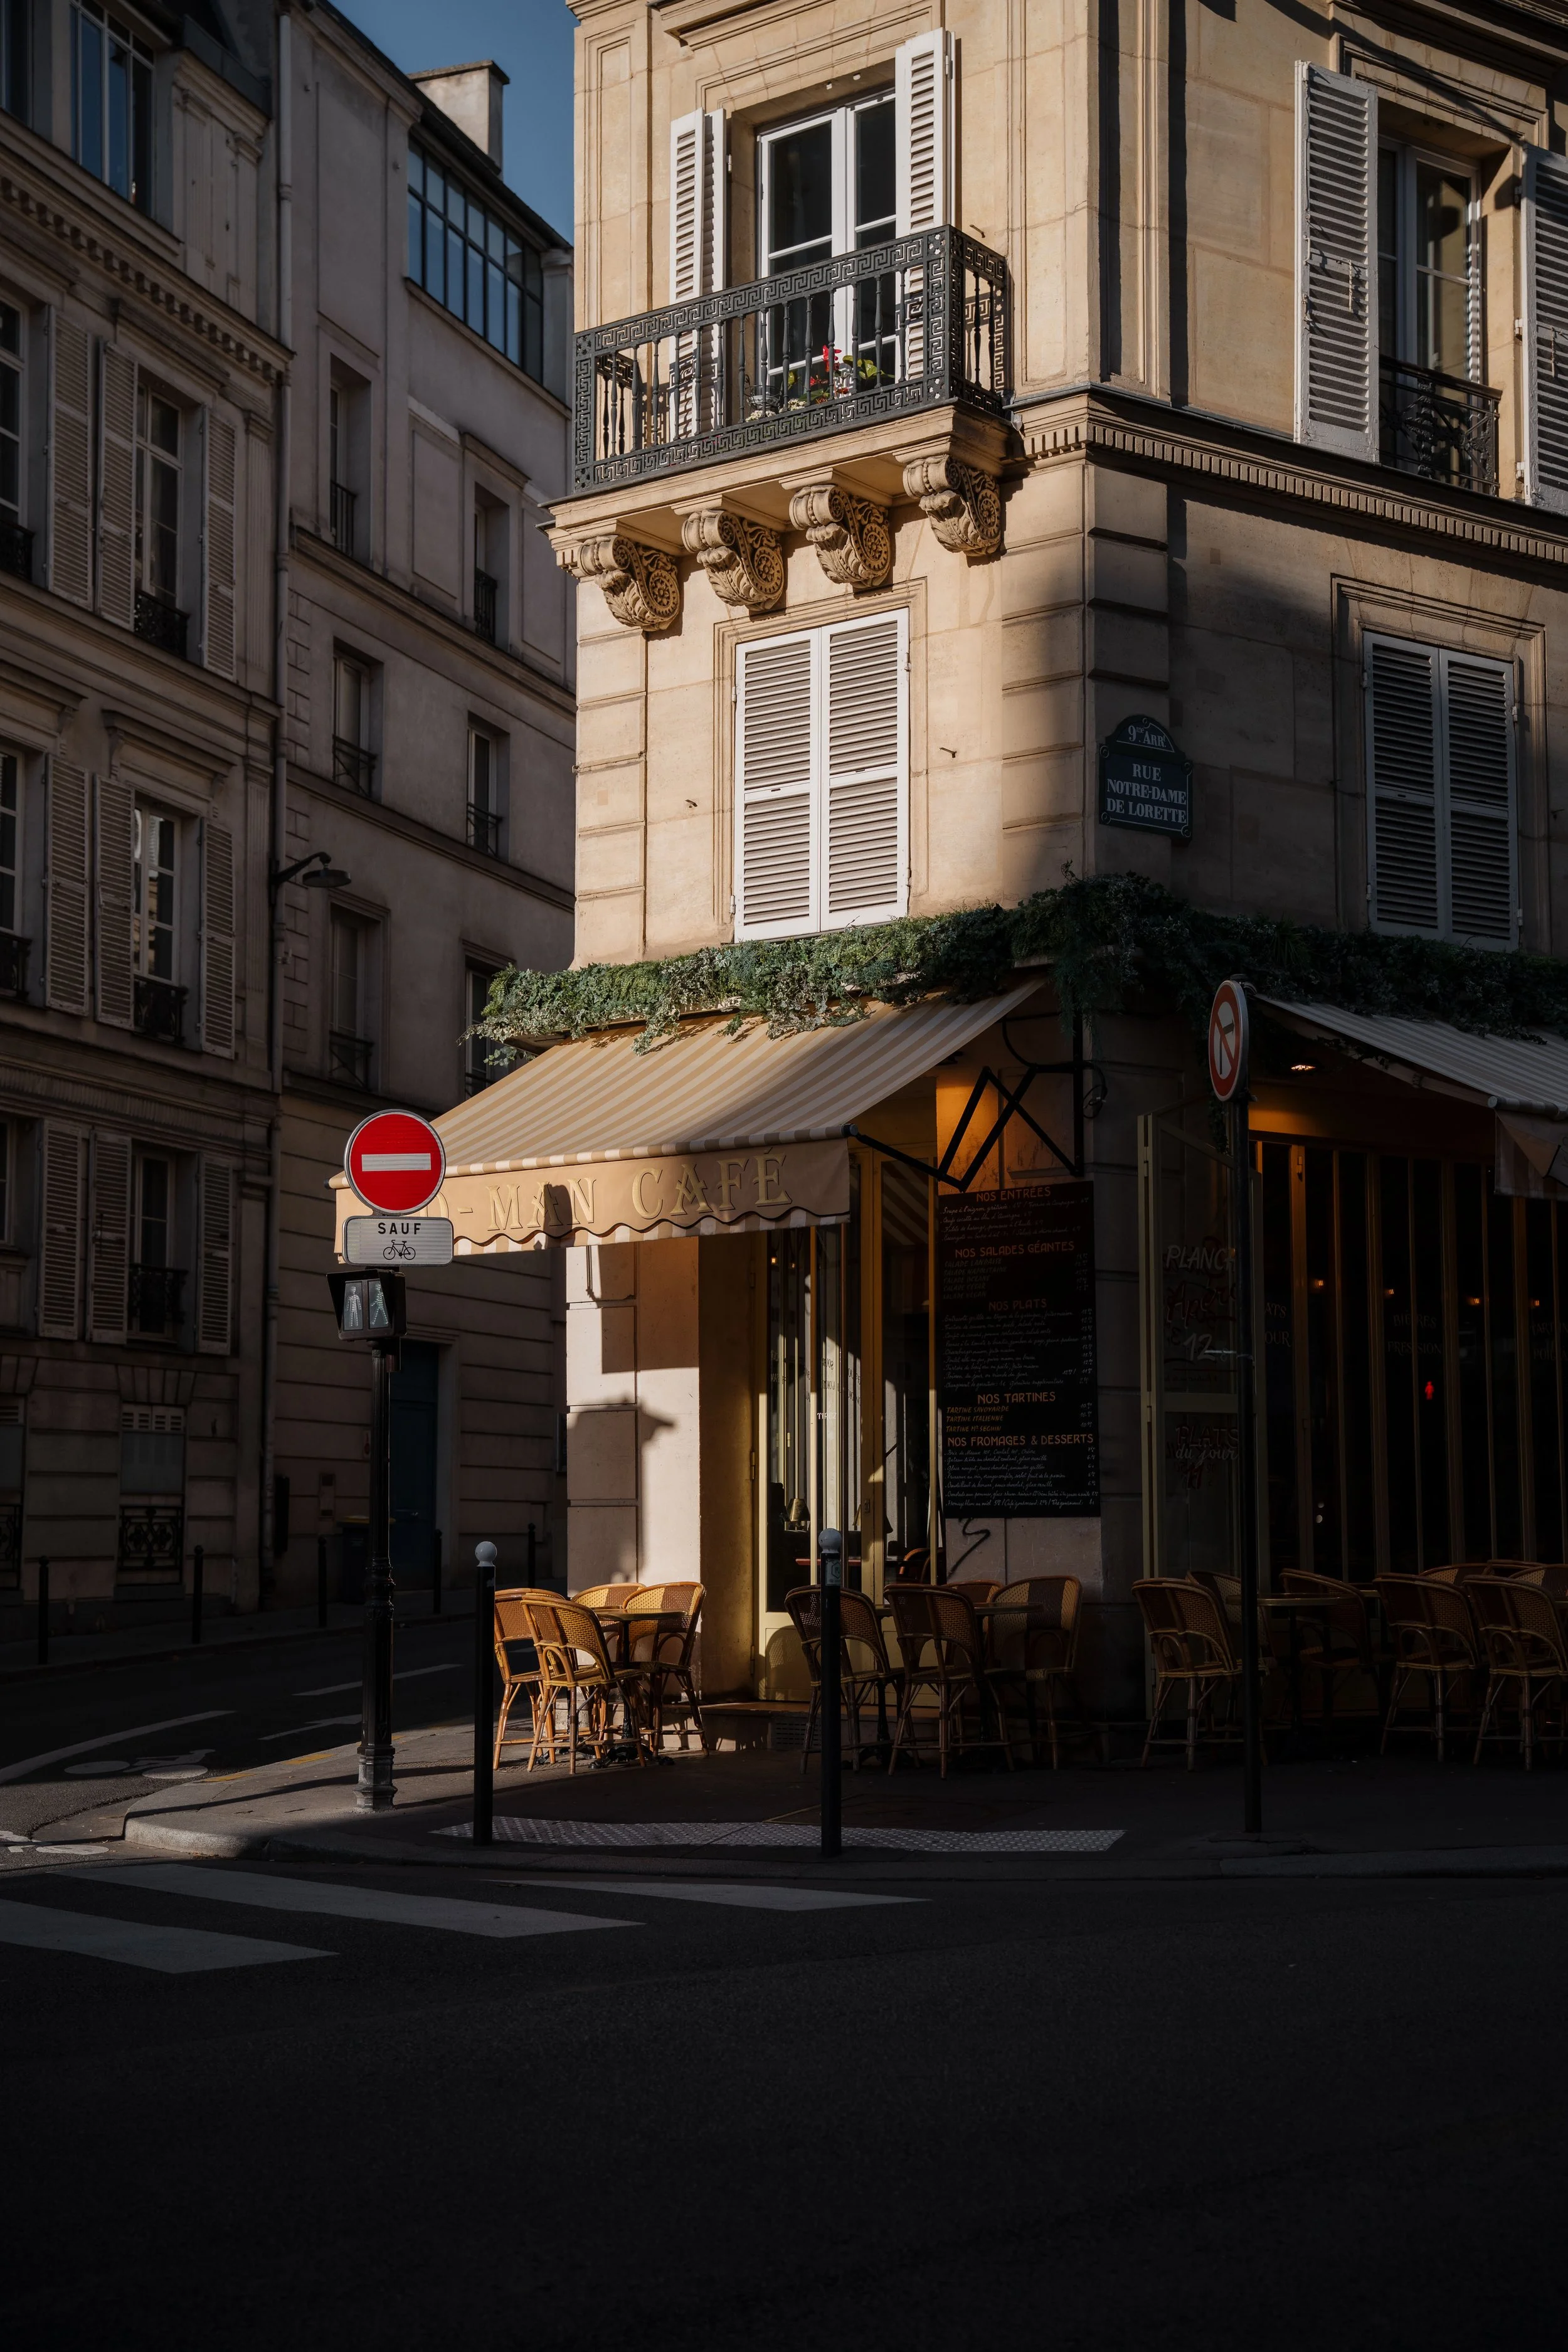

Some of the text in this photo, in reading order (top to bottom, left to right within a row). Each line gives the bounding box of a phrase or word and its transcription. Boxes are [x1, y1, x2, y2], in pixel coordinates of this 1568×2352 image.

[1132, 763, 1162, 781] RUE
[1106, 778, 1187, 805] NOTRE-DAME
[1106, 797, 1187, 824] DE LORETTE
[632, 1147, 793, 1221] CAFÉ
[976, 1186, 1051, 1202] NOS ENTRÉES
[378, 1222, 421, 1235] SAUF
[955, 1240, 1075, 1259] NOS SALADES GÉANTES
[988, 1298, 1047, 1312] NOS PLATS
[1264, 1330, 1292, 1348] OUR
[977, 1391, 1056, 1406] NOS TARTINES
[947, 1433, 1094, 1447] NOS FROMAGES & DESSERTS
[1175, 1443, 1241, 1469] du jour
